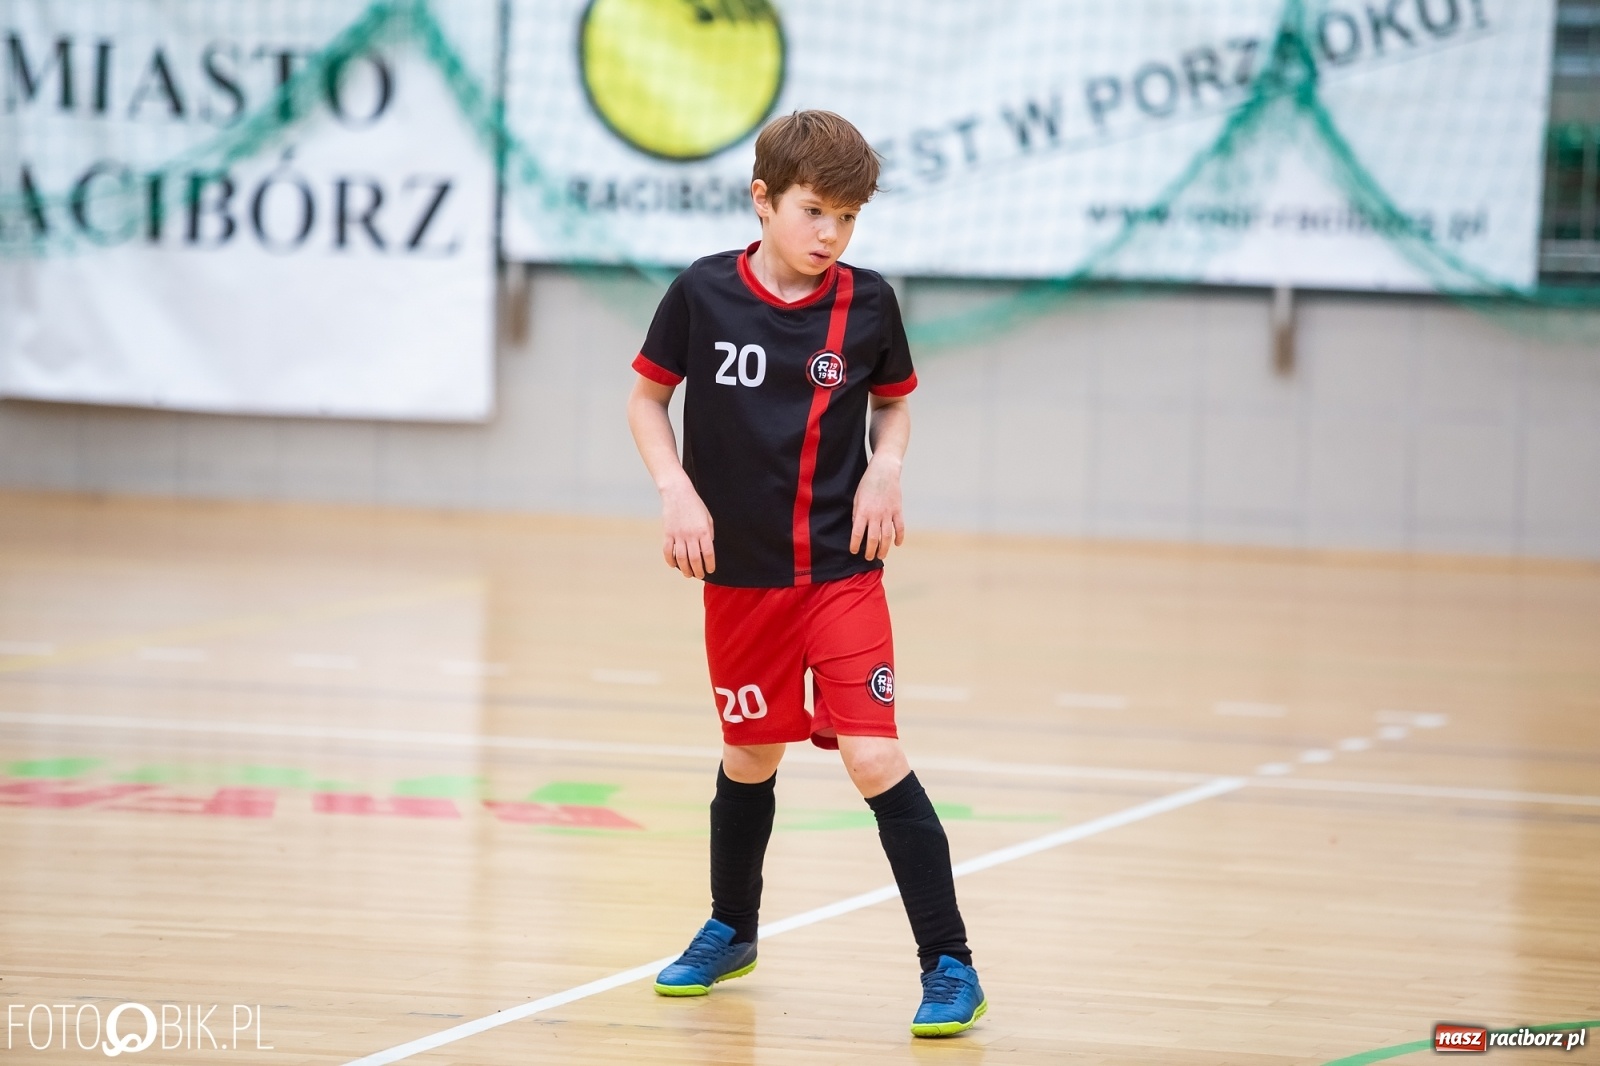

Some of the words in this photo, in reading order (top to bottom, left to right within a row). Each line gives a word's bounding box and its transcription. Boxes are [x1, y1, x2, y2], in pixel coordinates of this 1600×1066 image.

[5, 30, 394, 132] MIASTO
[1000, 94, 1064, 152] W
[0, 145, 462, 260] ACIBÓRZ
[714, 341, 767, 388] 20
[817, 360, 830, 372] R
[827, 369, 838, 380] R
[715, 684, 768, 724] 20
